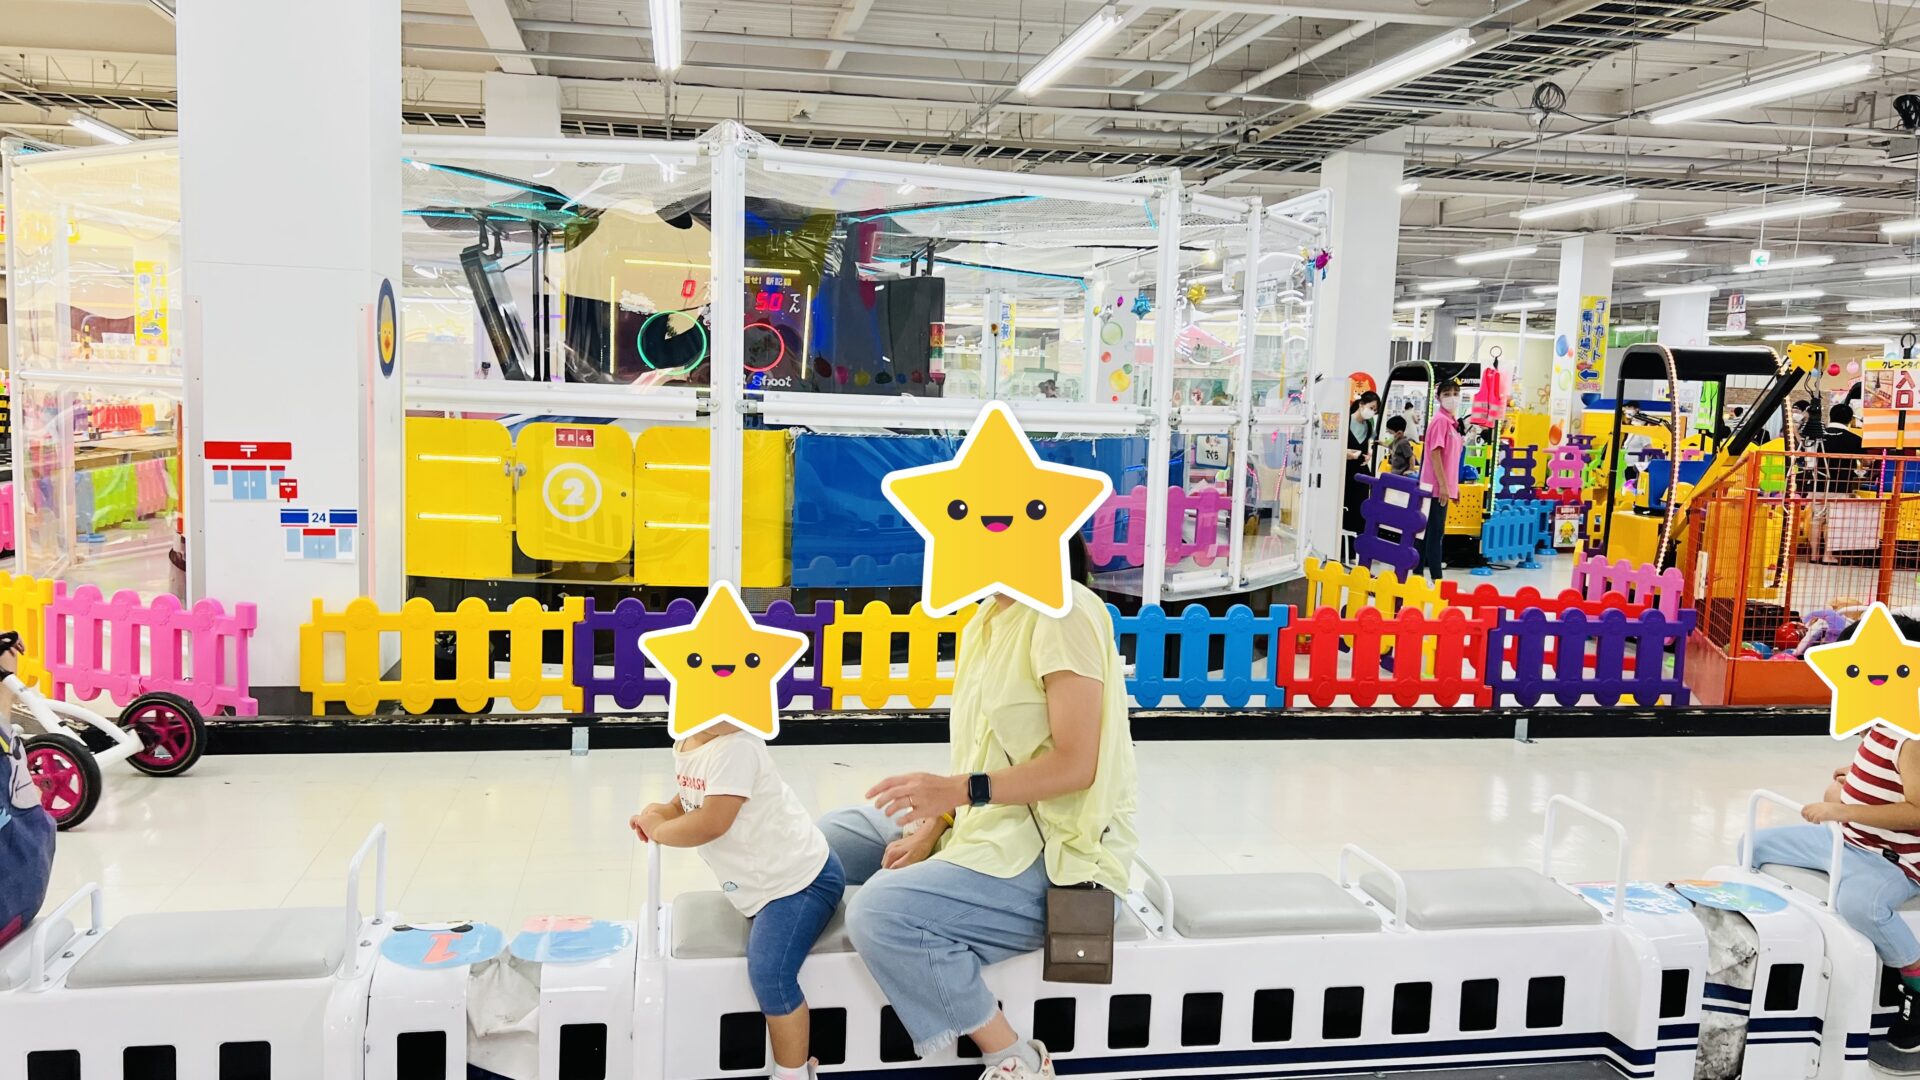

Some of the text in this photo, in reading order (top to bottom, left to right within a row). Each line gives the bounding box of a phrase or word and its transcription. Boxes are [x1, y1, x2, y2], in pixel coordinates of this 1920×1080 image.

[681, 279, 697, 298] 0
[789, 293, 801, 313] てん
[752, 374, 793, 387] Shoot
[1895, 370, 1916, 409] 入口
[561, 477, 585, 506] 2
[311, 512, 327, 524] 24
